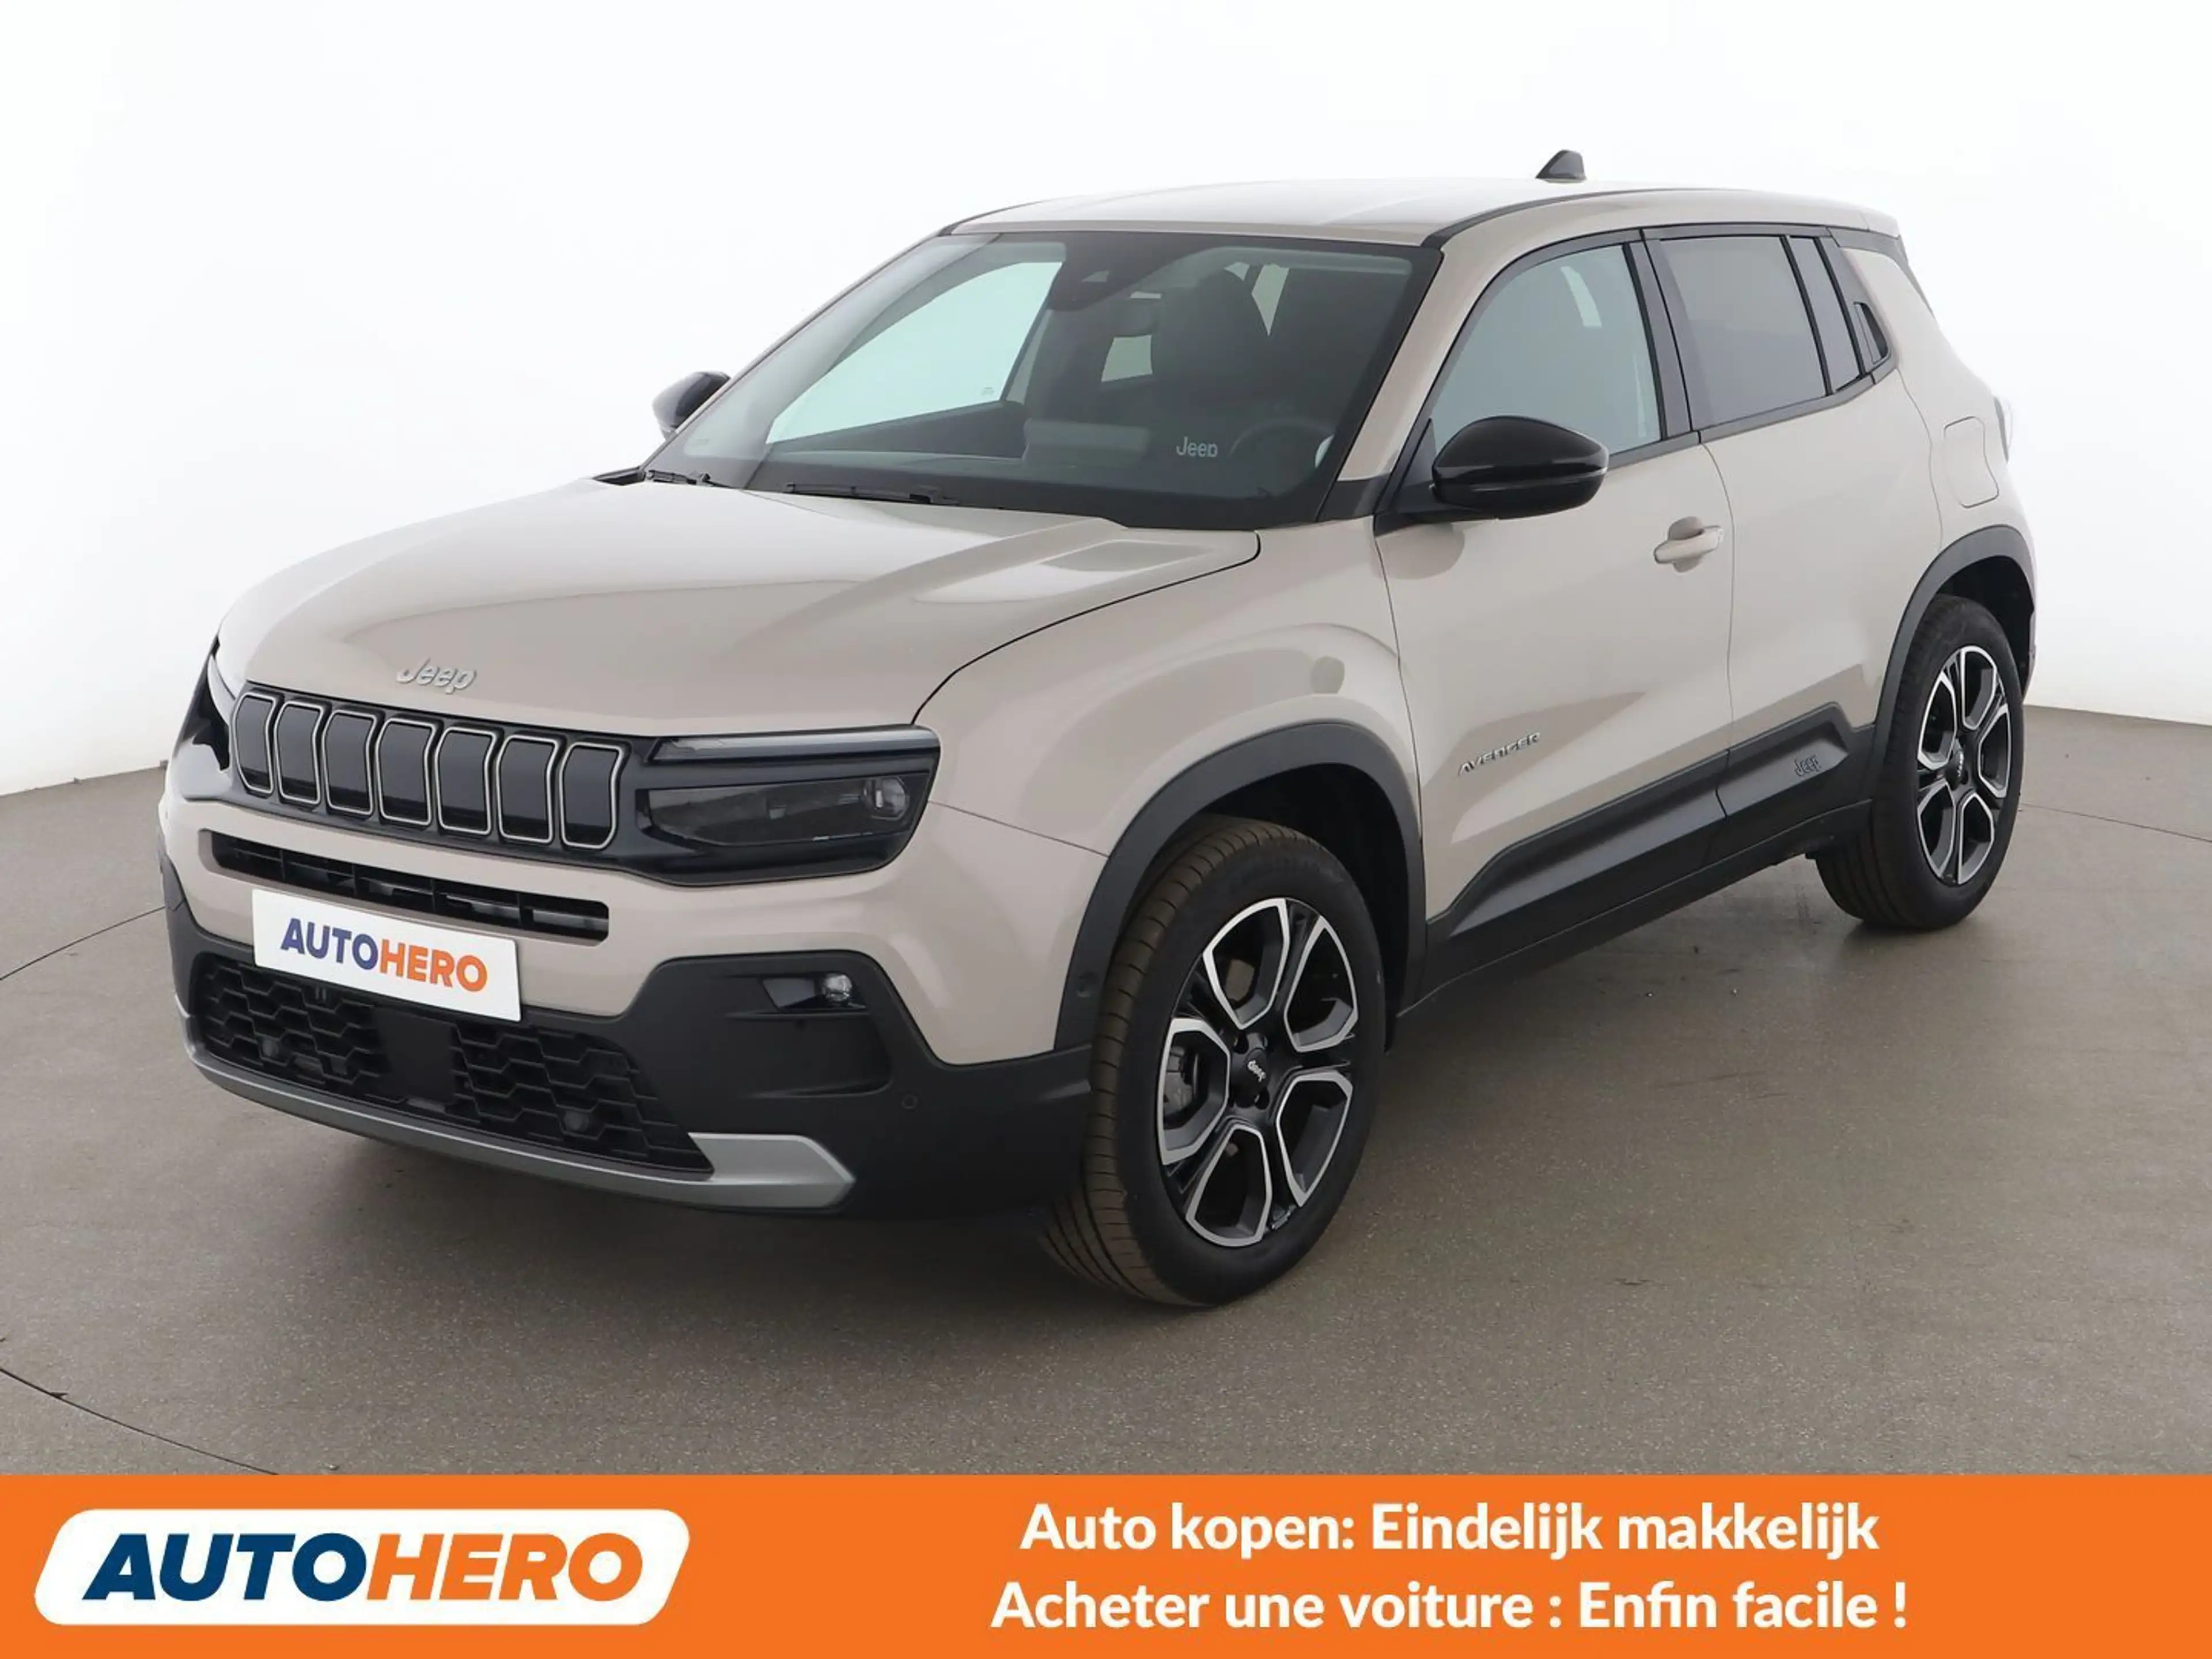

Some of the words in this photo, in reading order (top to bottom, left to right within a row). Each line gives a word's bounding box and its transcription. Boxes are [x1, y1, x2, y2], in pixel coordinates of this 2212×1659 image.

[1176, 436, 1218, 457] Jeep
[396, 657, 477, 695] Jeep
[1458, 732, 1540, 776] AVENGER
[281, 918, 488, 992] AUTOHERO
